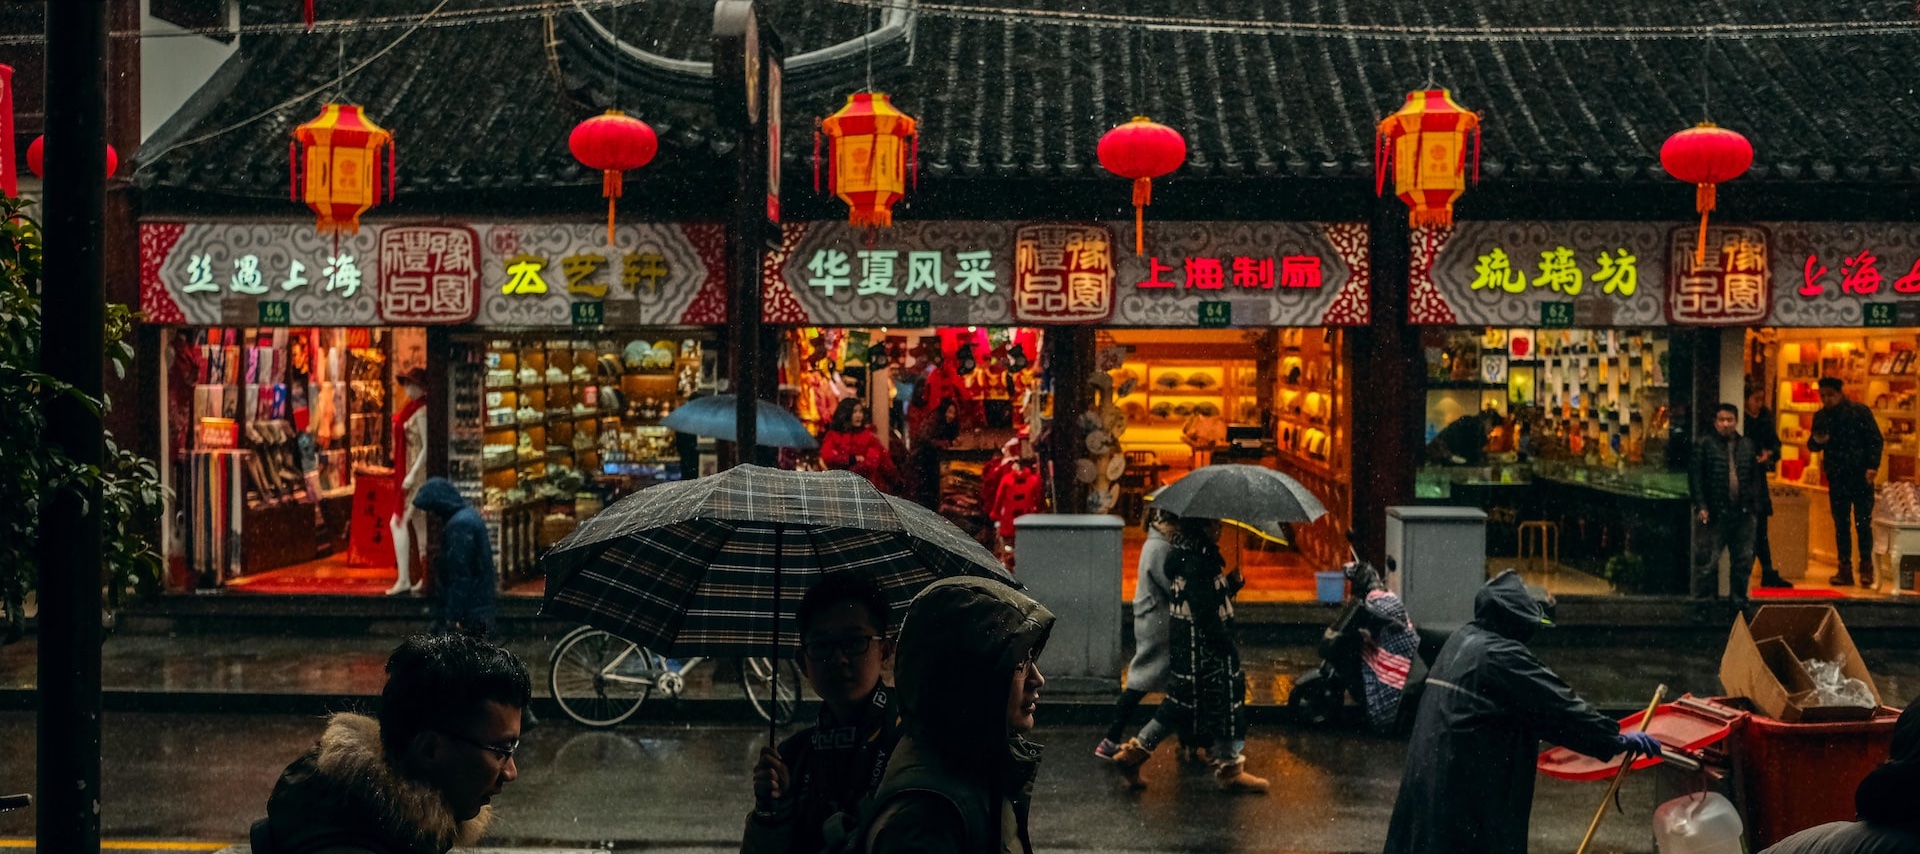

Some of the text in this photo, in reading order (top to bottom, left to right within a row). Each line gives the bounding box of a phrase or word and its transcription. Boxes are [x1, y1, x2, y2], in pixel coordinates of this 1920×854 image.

[182, 253, 362, 298] 丝遇上海
[807, 248, 997, 297] 华夏风采
[1136, 255, 1322, 290] 上海制扇
[1470, 246, 1638, 297] 琉璃坊
[266, 303, 282, 317] 66
[579, 303, 596, 317] 66
[905, 304, 922, 317] 64
[1206, 303, 1223, 316] 64
[1549, 305, 1566, 318] 62
[1872, 305, 1888, 319] 62
[869, 748, 887, 788] SONY
